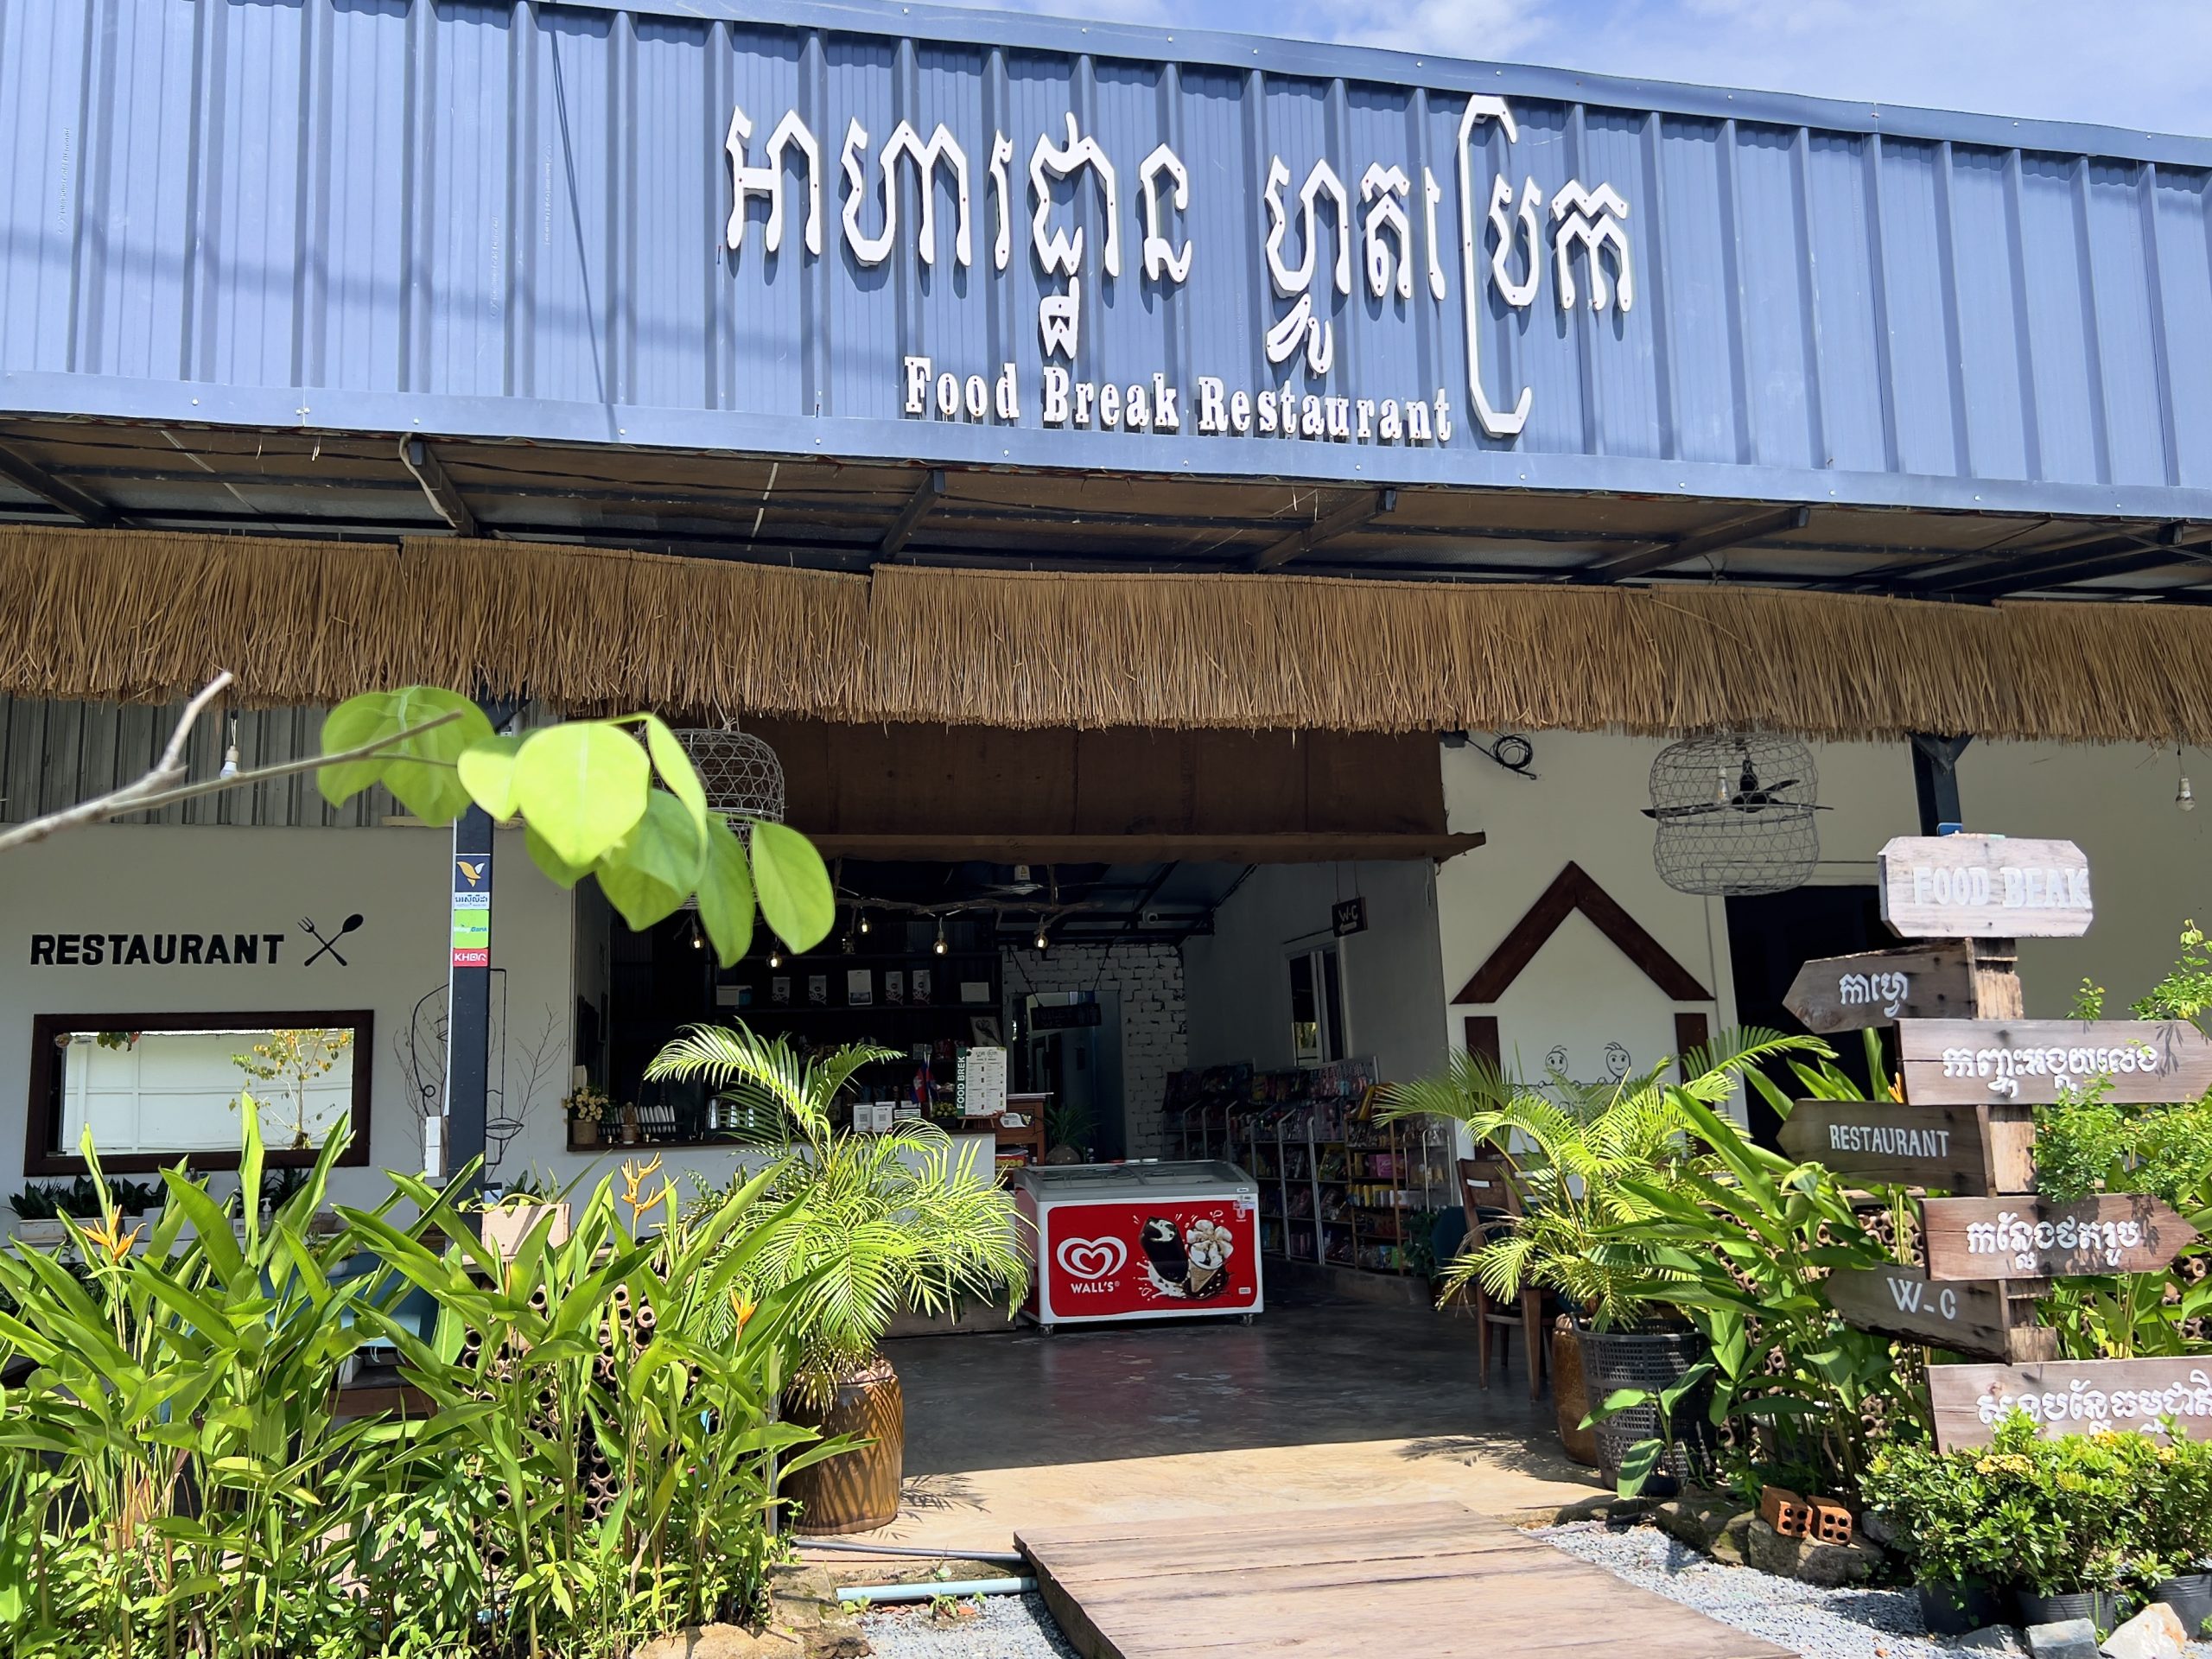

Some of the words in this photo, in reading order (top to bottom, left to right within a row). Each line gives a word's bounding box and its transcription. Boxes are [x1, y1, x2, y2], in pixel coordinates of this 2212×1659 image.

[904, 356, 1020, 418] Food
[1043, 366, 1180, 428] Break
[1198, 376, 1452, 442] Restaurant
[1912, 867, 1990, 906] FOOD
[1999, 867, 2093, 909] BEAK
[30, 933, 285, 966] RESTAURANT
[957, 1056, 966, 1081] BREK
[957, 1083, 965, 1109] FOOD
[1829, 1124, 1949, 1158] RESTAURANT
[1071, 1281, 1115, 1294] WALL'S
